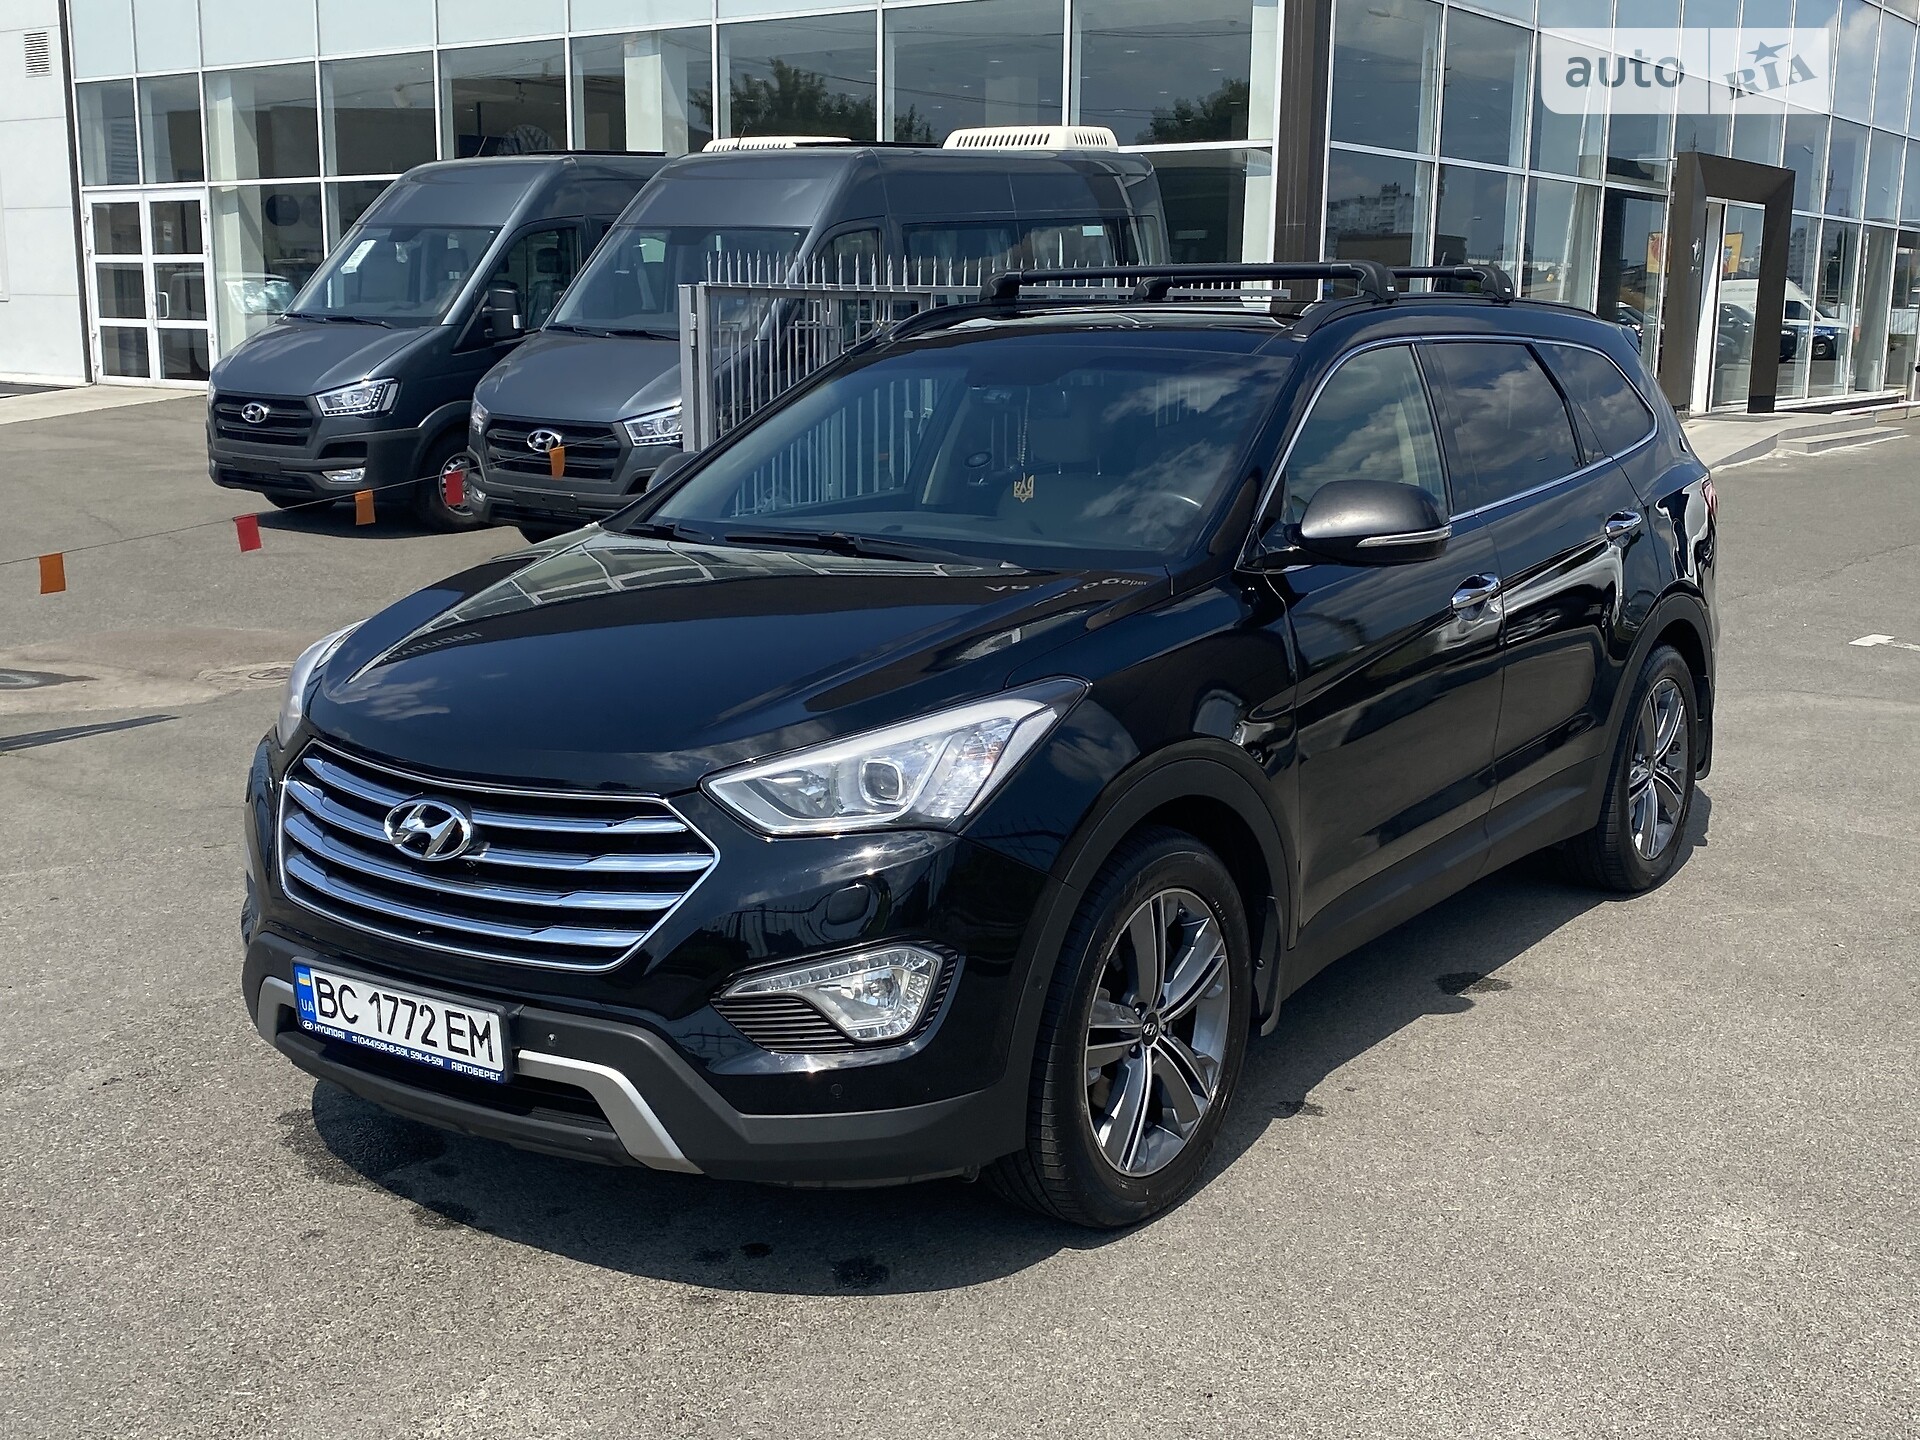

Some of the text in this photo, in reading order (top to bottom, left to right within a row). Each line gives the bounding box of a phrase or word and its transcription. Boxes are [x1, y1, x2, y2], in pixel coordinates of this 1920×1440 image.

[301, 998, 315, 1014] UA
[314, 976, 494, 1063] BC 1772 EM
[314, 1023, 345, 1040] HYUNDAI
[451, 1061, 501, 1082] АВТОБЕРЕГ
